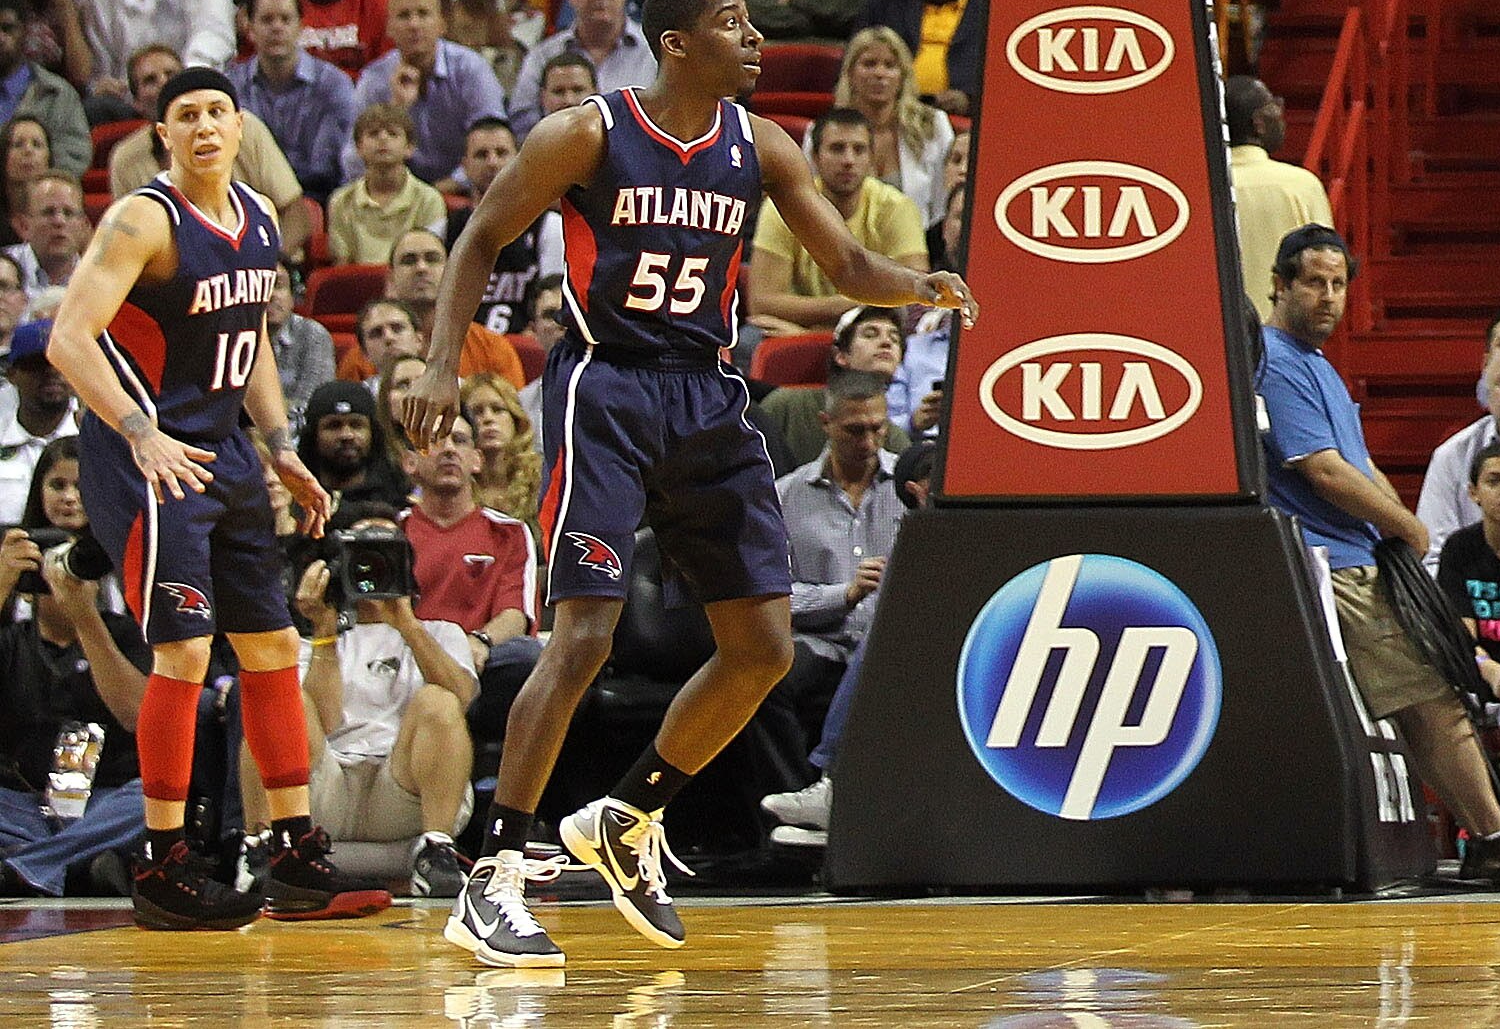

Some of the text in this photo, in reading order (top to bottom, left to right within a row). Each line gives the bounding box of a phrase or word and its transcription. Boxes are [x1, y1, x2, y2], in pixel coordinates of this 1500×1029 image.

[1037, 27, 1147, 72] KIA
[611, 186, 748, 236] ATLANTA
[1029, 184, 1160, 238] KIA
[480, 264, 538, 302] EAT
[624, 251, 710, 315] 55
[486, 304, 513, 335] 6
[210, 330, 258, 391] 10
[1021, 360, 1166, 421] KIA
[986, 554, 1199, 820] hp
